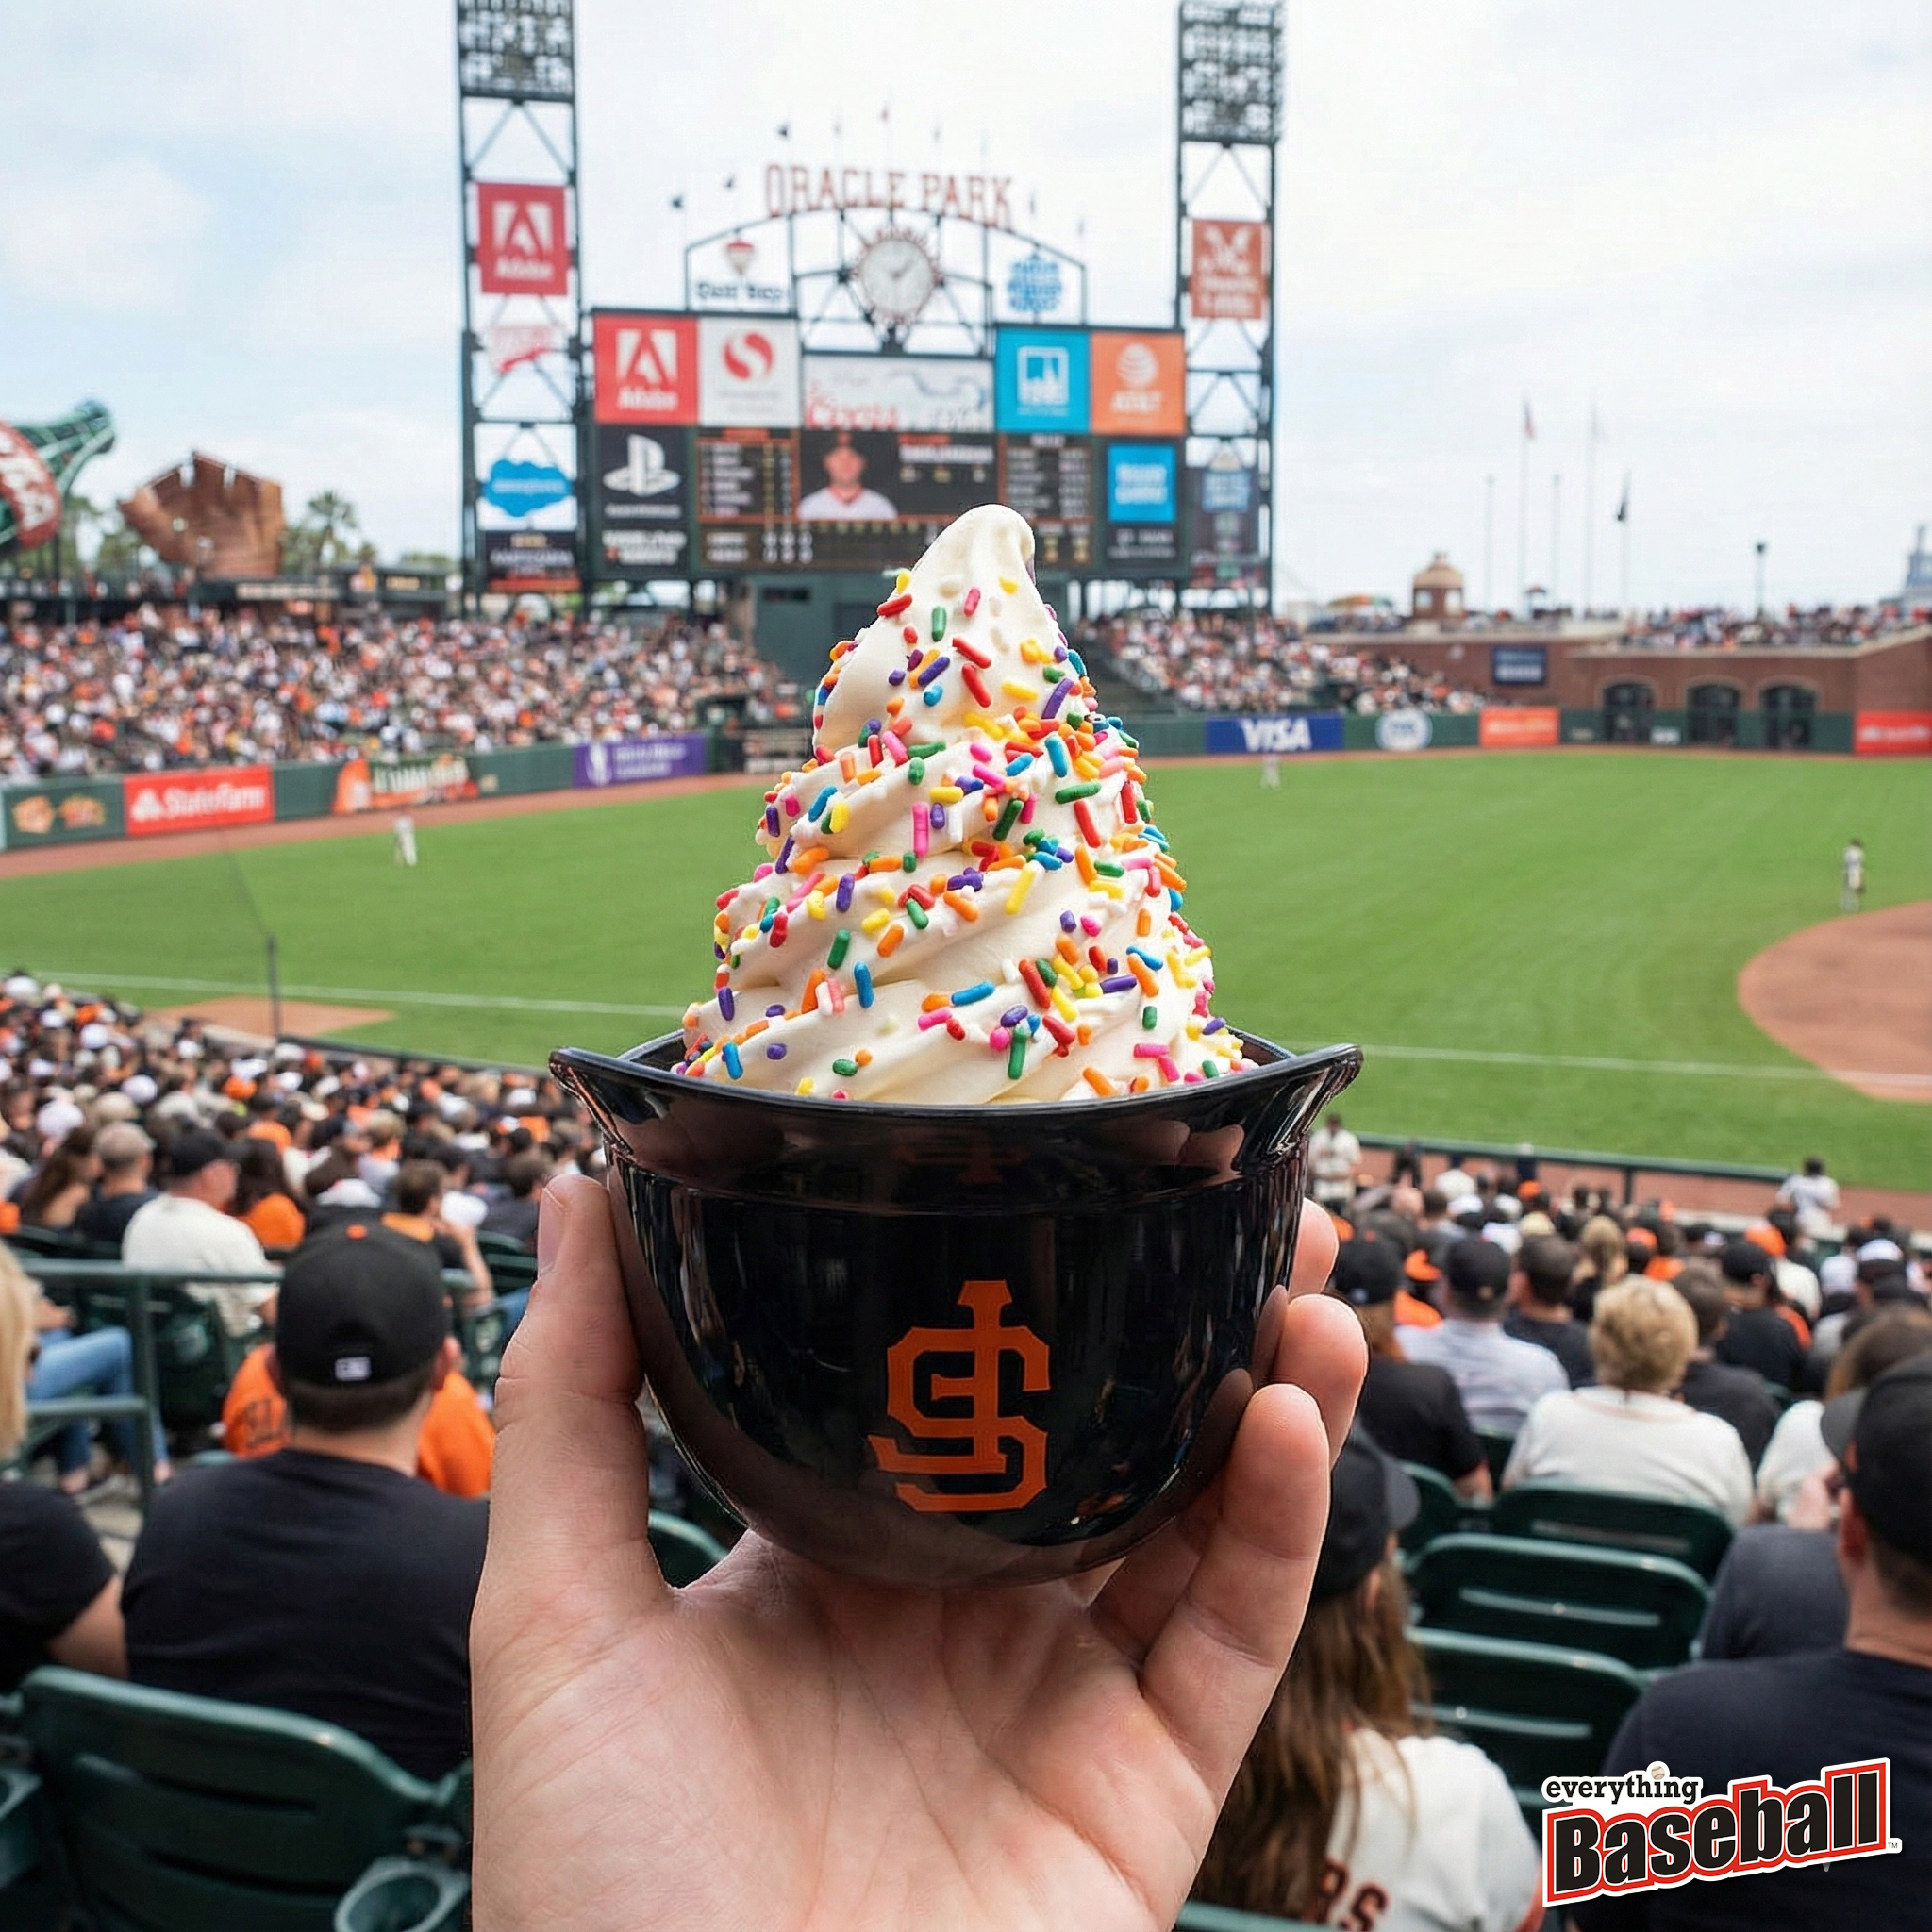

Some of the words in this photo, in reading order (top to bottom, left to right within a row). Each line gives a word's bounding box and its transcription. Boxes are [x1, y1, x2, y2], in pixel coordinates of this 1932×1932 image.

[766, 164, 906, 218] ORACLE
[920, 173, 1013, 231] PARK
[1239, 717, 1312, 752] VISA
